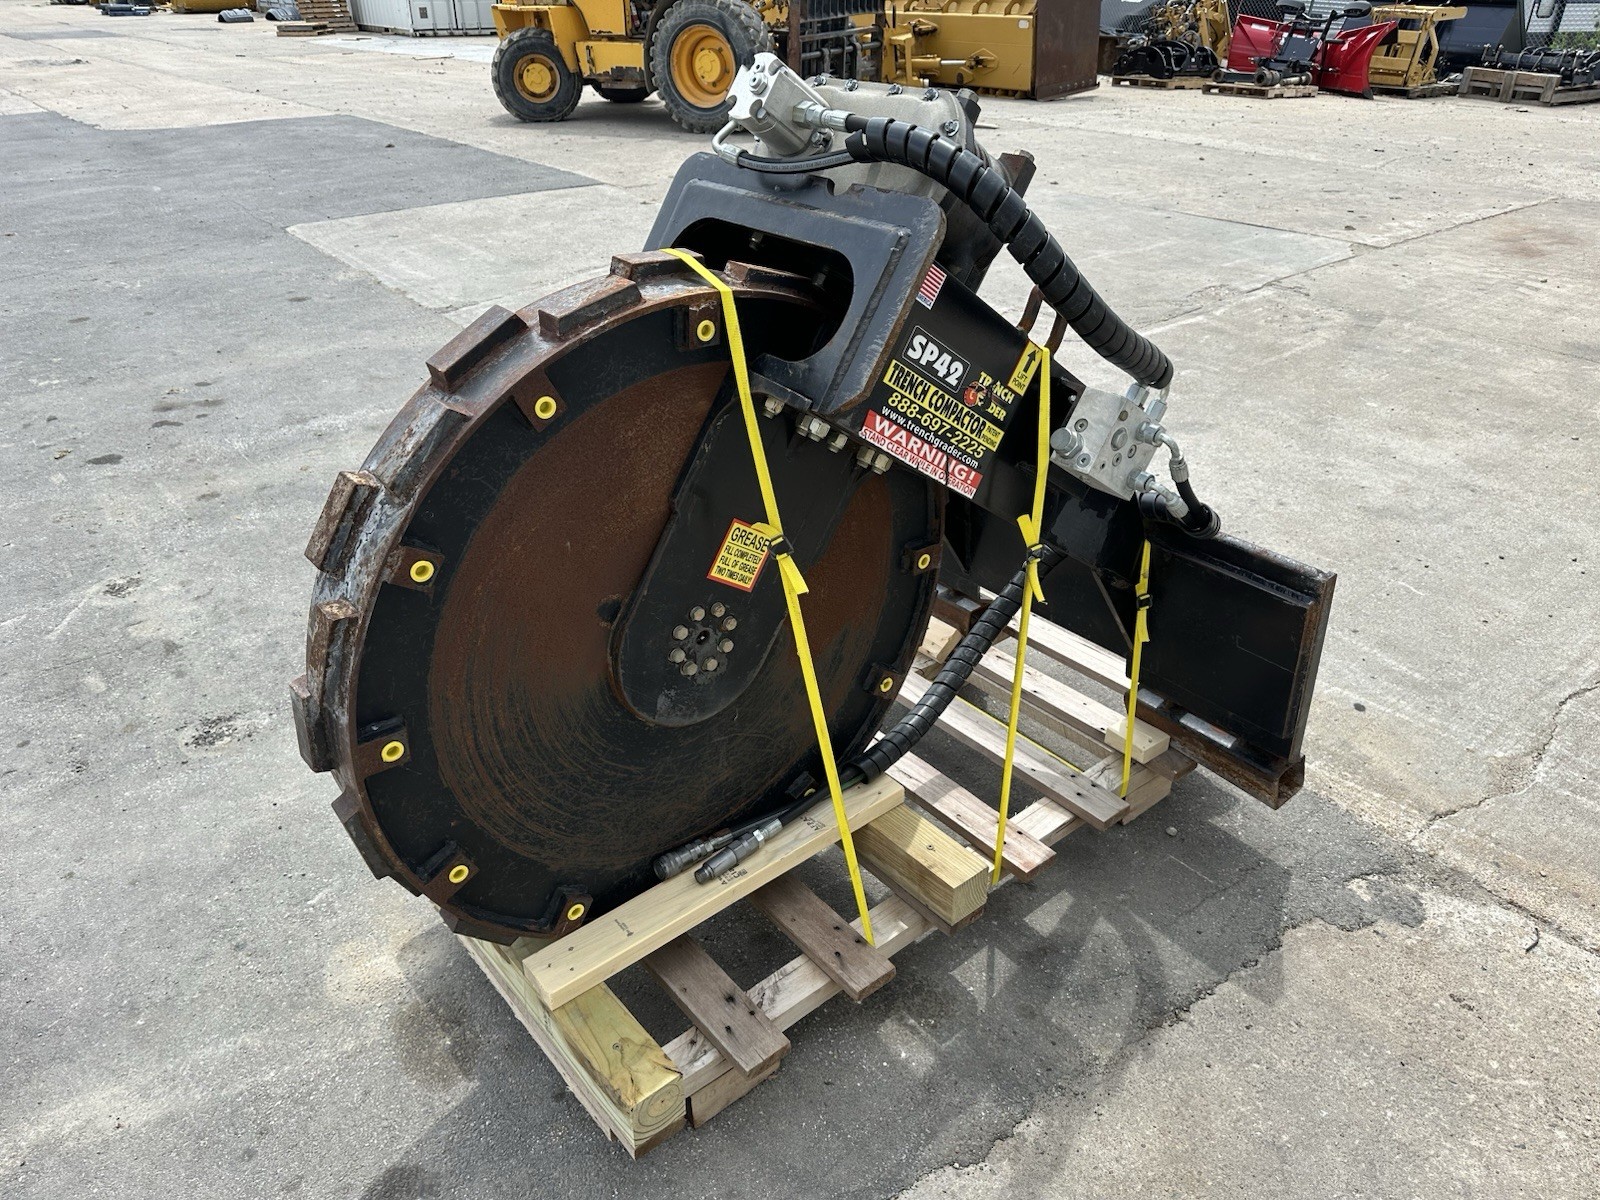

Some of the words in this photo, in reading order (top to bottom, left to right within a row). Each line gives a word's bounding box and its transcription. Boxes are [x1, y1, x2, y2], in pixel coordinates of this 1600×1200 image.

[907, 334, 964, 387] SP42
[979, 371, 1015, 405] TRNCH
[1012, 378, 1026, 390] POINT
[1017, 372, 1027, 382] LIFT
[888, 361, 931, 403] TRENCH
[928, 389, 987, 440] COMPACTOR
[881, 406, 979, 469] www.trenchgrader.com
[888, 392, 986, 459] 888-697-2225
[986, 425, 1001, 438] PATENT
[862, 428, 887, 446] STAND
[886, 442, 908, 460] CLEAR
[909, 455, 930, 471] WHILE
[930, 466, 940, 477] IN
[939, 470, 975, 496] OERATION
[874, 415, 976, 485] WARNING!
[731, 527, 771, 552] GREASE
[719, 555, 731, 566] FULL
[731, 560, 739, 568] OF
[739, 562, 757, 575] GREASE
[724, 545, 734, 556] FILL
[733, 549, 762, 565] COMPLETELY
[715, 566, 726, 576] TWO
[725, 569, 739, 581] TIMES
